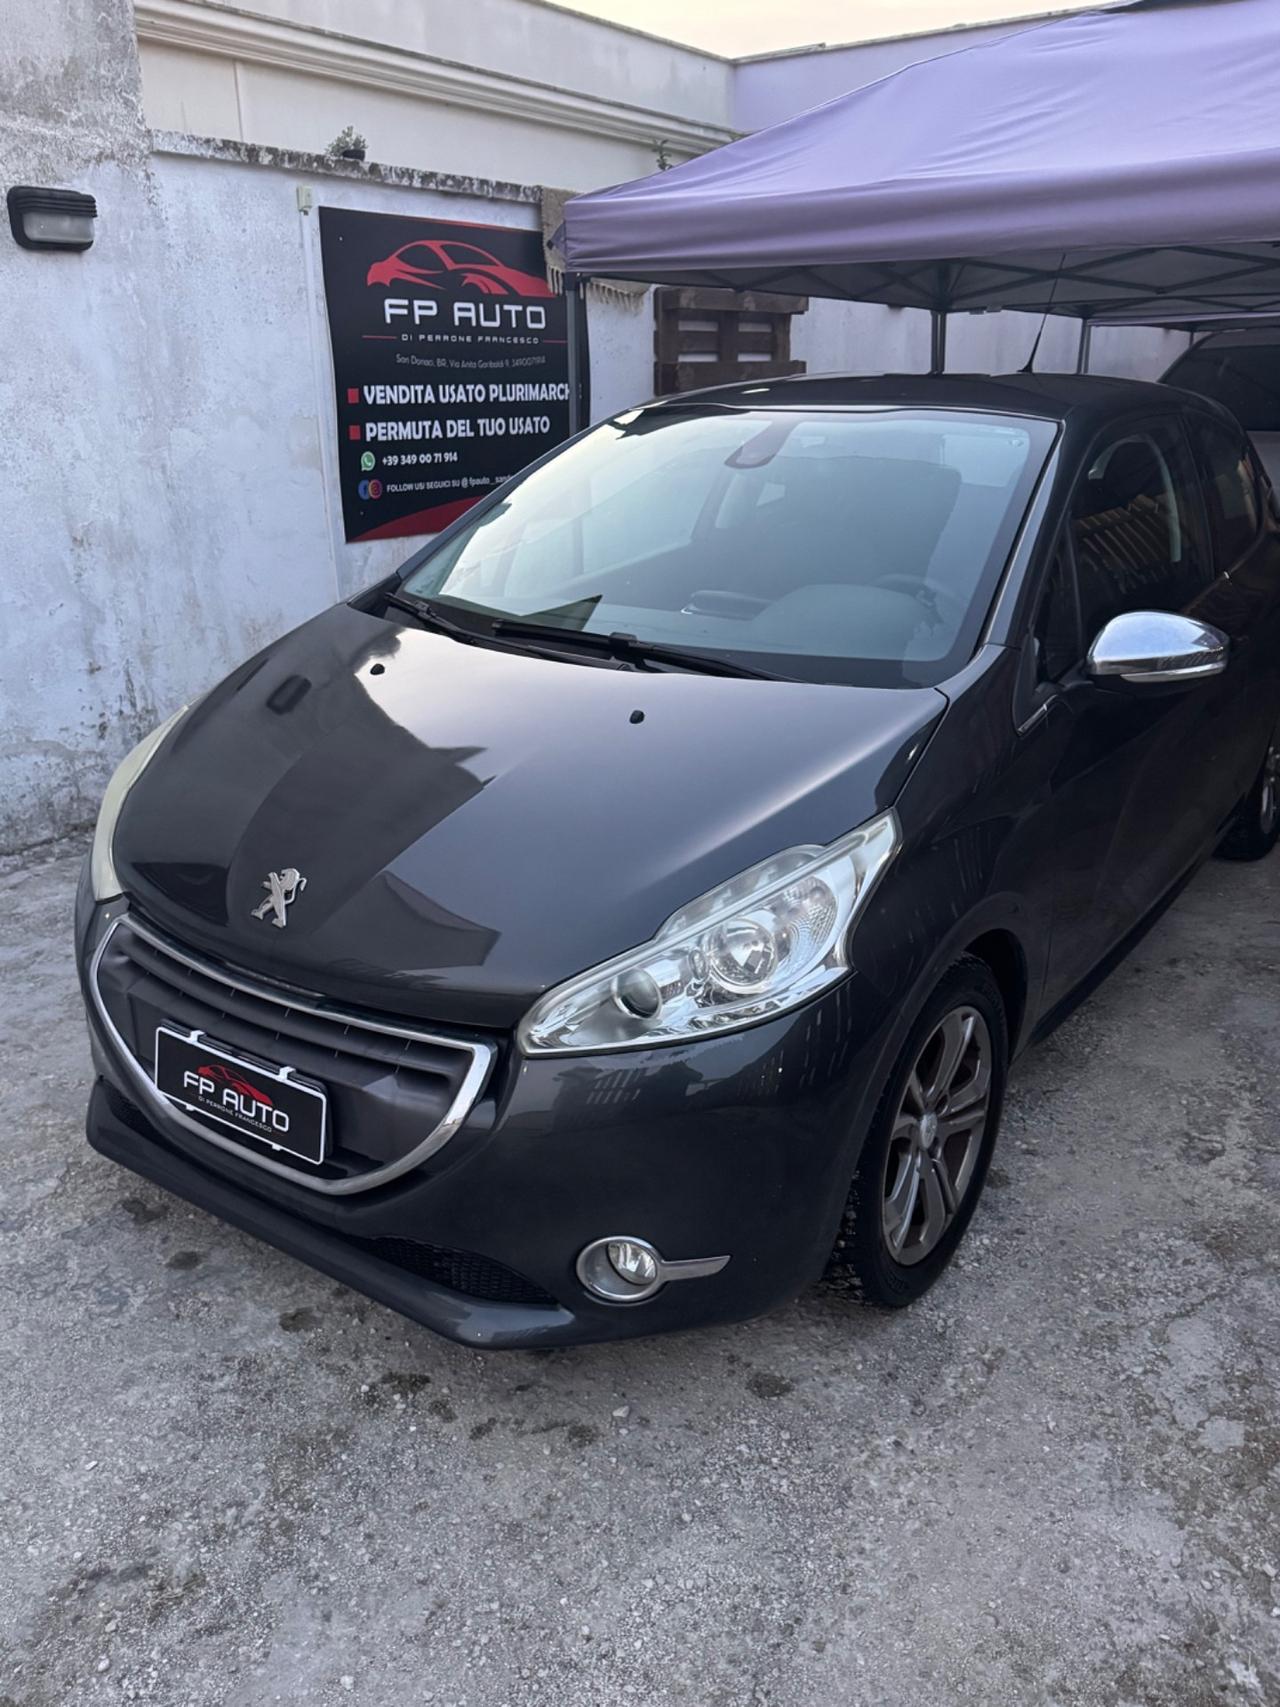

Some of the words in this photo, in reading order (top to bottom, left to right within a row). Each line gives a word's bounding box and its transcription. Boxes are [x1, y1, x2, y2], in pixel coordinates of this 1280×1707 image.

[384, 298, 438, 325] FP
[453, 301, 546, 329] AUTO
[401, 333, 413, 342] DI
[419, 334, 472, 343] PERRONE
[477, 336, 539, 345] FRANCESCO
[363, 385, 436, 405] VENDITA
[439, 384, 486, 404] USATO
[489, 382, 582, 402] PLURIMARCH
[365, 420, 443, 442] PERMUTA
[446, 419, 474, 438] DEL
[477, 417, 506, 436] TUO
[509, 415, 551, 435] USATO
[382, 455, 399, 466] +39
[400, 454, 417, 465] 349
[419, 453, 433, 464] 00
[433, 452, 442, 463] 71
[443, 451, 458, 463] 914
[386, 483, 413, 493] FOLLOW
[183, 1070, 215, 1095] FP
[222, 1087, 290, 1132] AUTO
[206, 1099, 234, 1116] PERRONE
[234, 1111, 272, 1133] FRANCESCO
